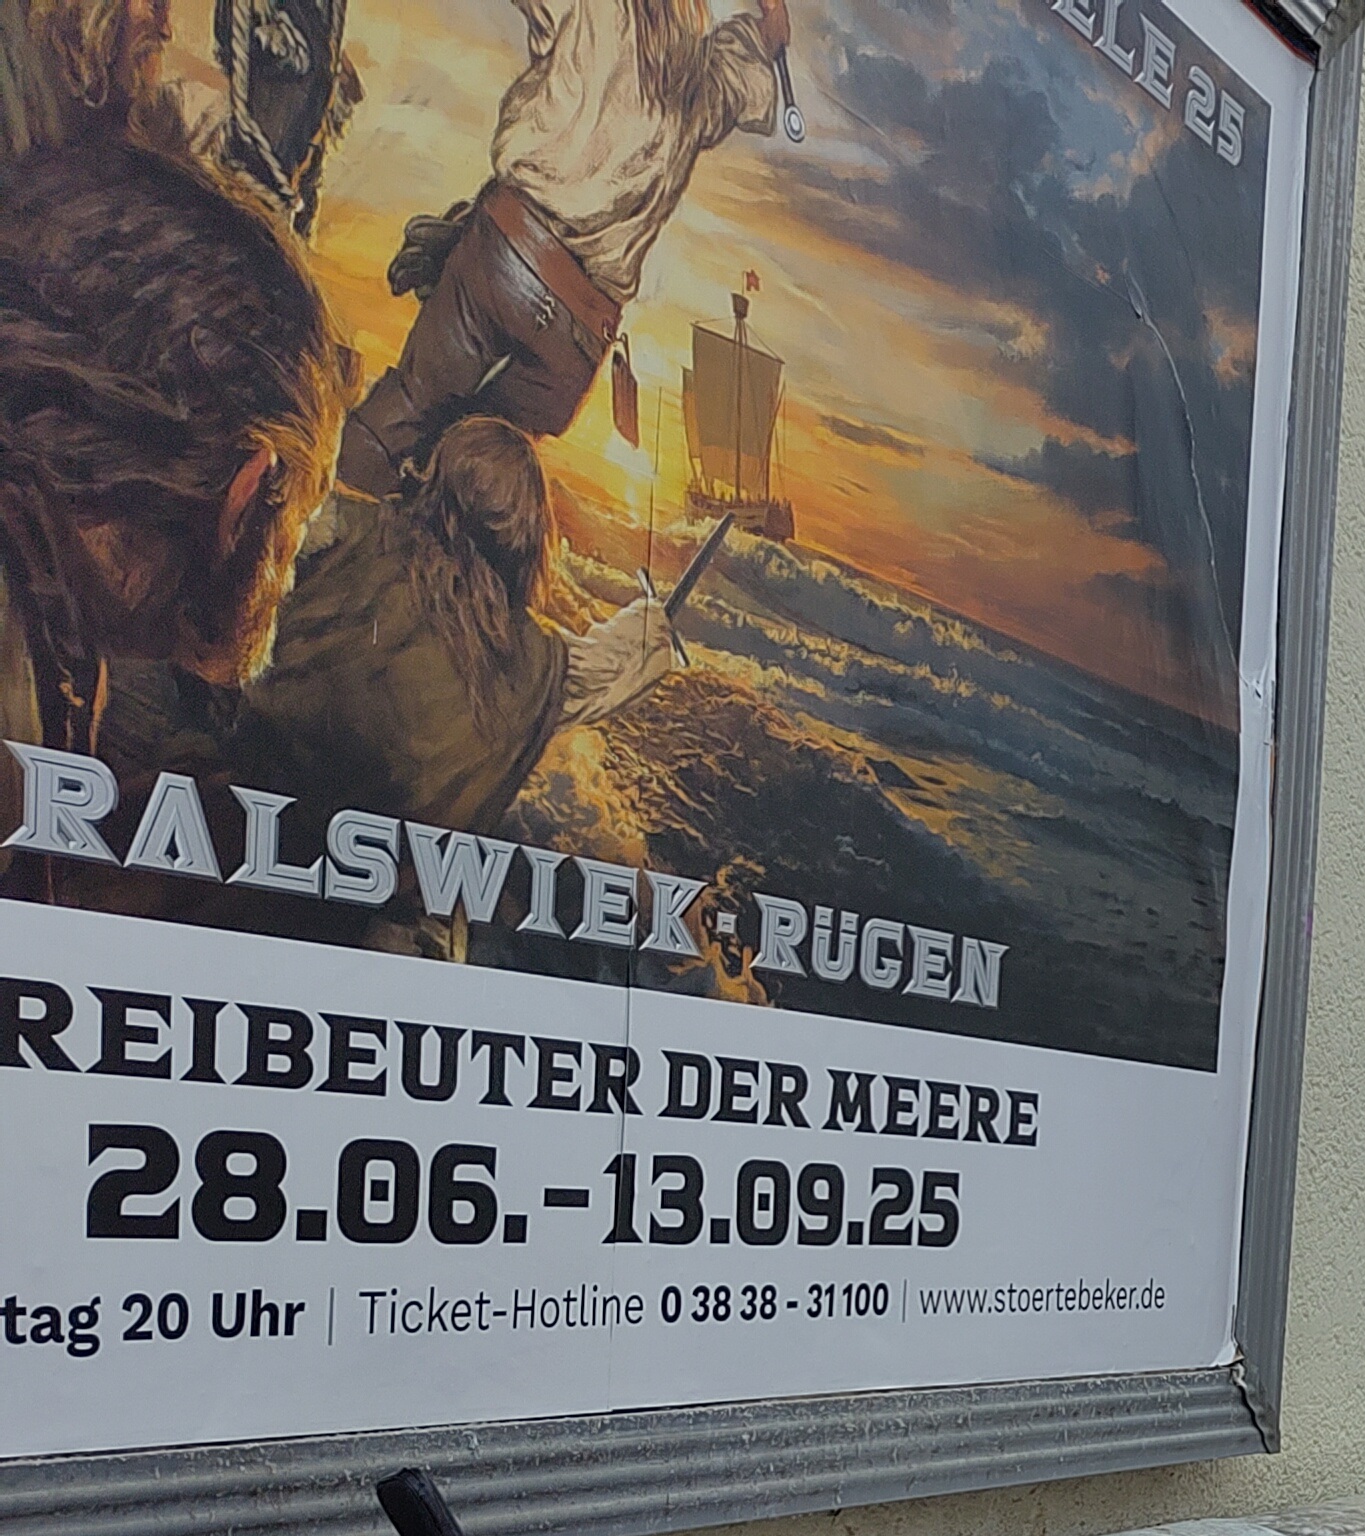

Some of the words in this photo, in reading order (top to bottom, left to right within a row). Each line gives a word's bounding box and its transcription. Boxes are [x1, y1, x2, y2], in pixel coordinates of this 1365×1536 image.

[1184, 65, 1245, 166] 25
[2, 739, 708, 957] RALSWIEK
[750, 892, 1009, 1008] RÜGEN
[0, 976, 643, 1116] REIBEUTER
[659, 1049, 811, 1129] DER
[822, 1068, 1039, 1146] MEERE
[122, 1292, 189, 1341] 20
[211, 1289, 305, 1337] Uhr
[358, 1284, 643, 1335] Ticket-Hotline
[919, 1277, 1166, 1315] www.stoertebeker.de
